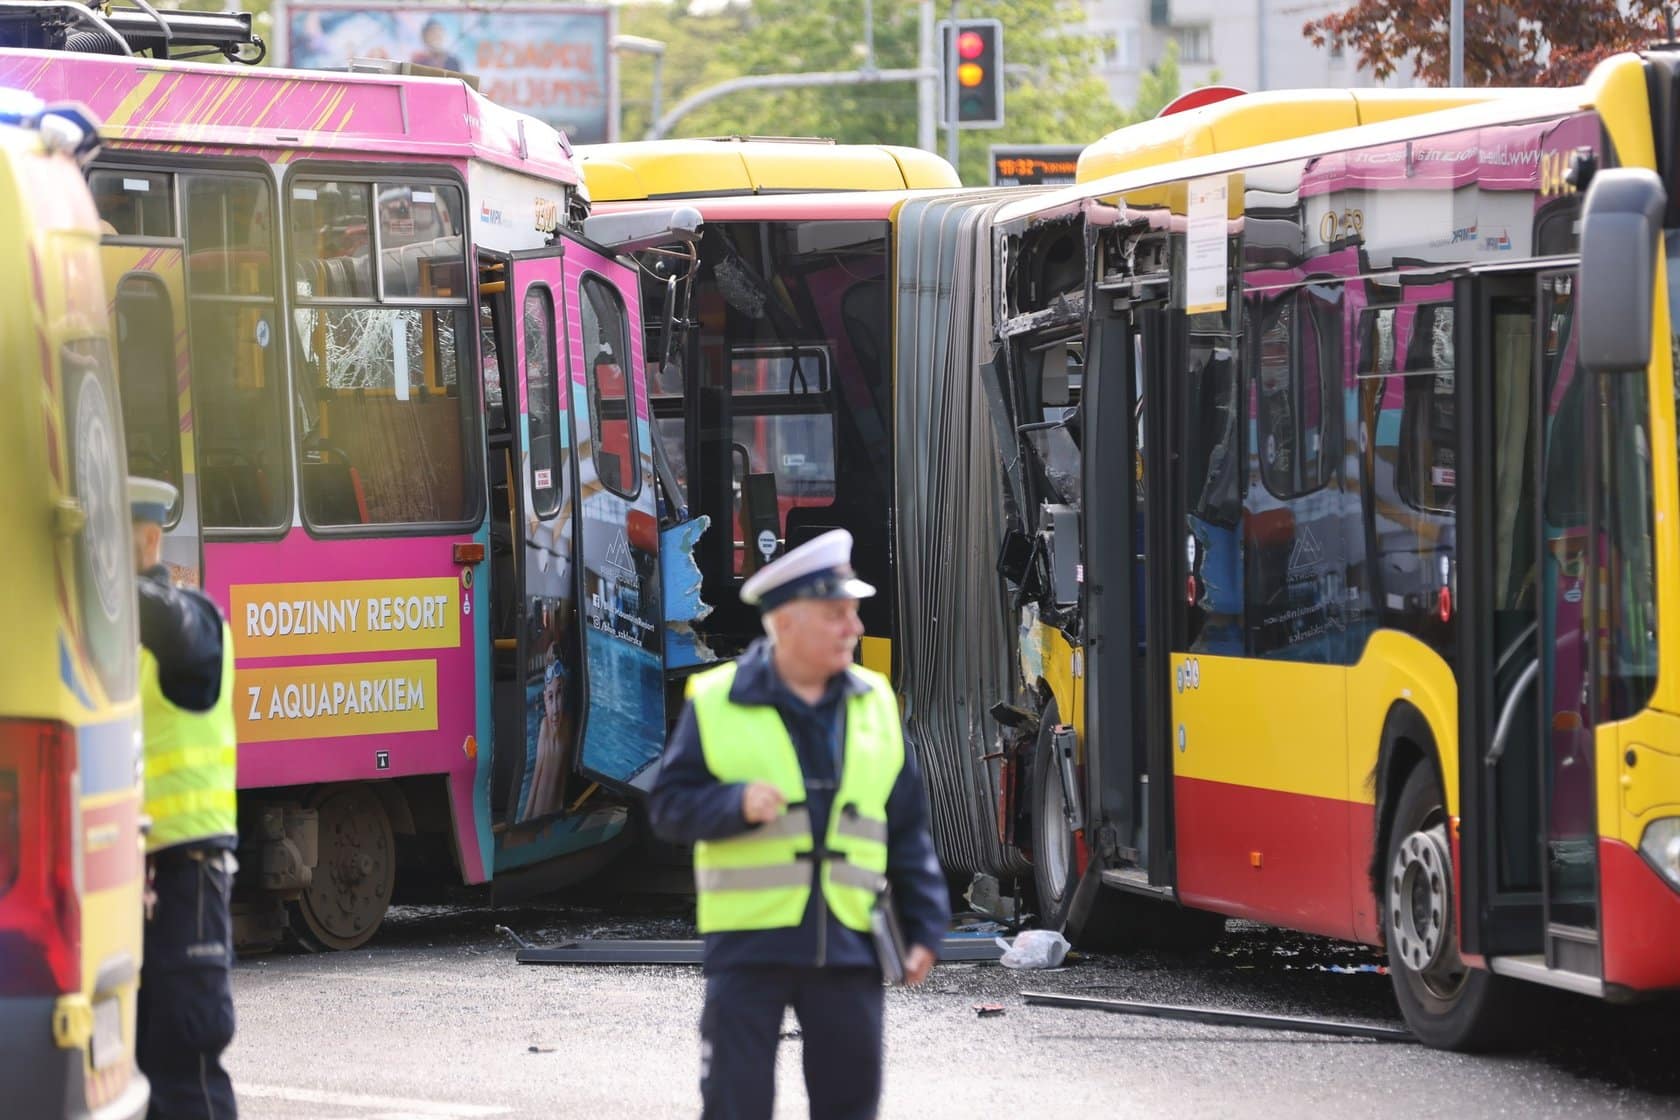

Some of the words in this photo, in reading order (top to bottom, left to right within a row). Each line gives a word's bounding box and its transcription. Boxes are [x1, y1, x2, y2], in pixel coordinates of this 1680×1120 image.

[246, 599, 361, 637] RODZINNY
[367, 596, 449, 632] RESORT
[248, 686, 262, 720] Z
[268, 675, 425, 719] AQUAPARKIEM
